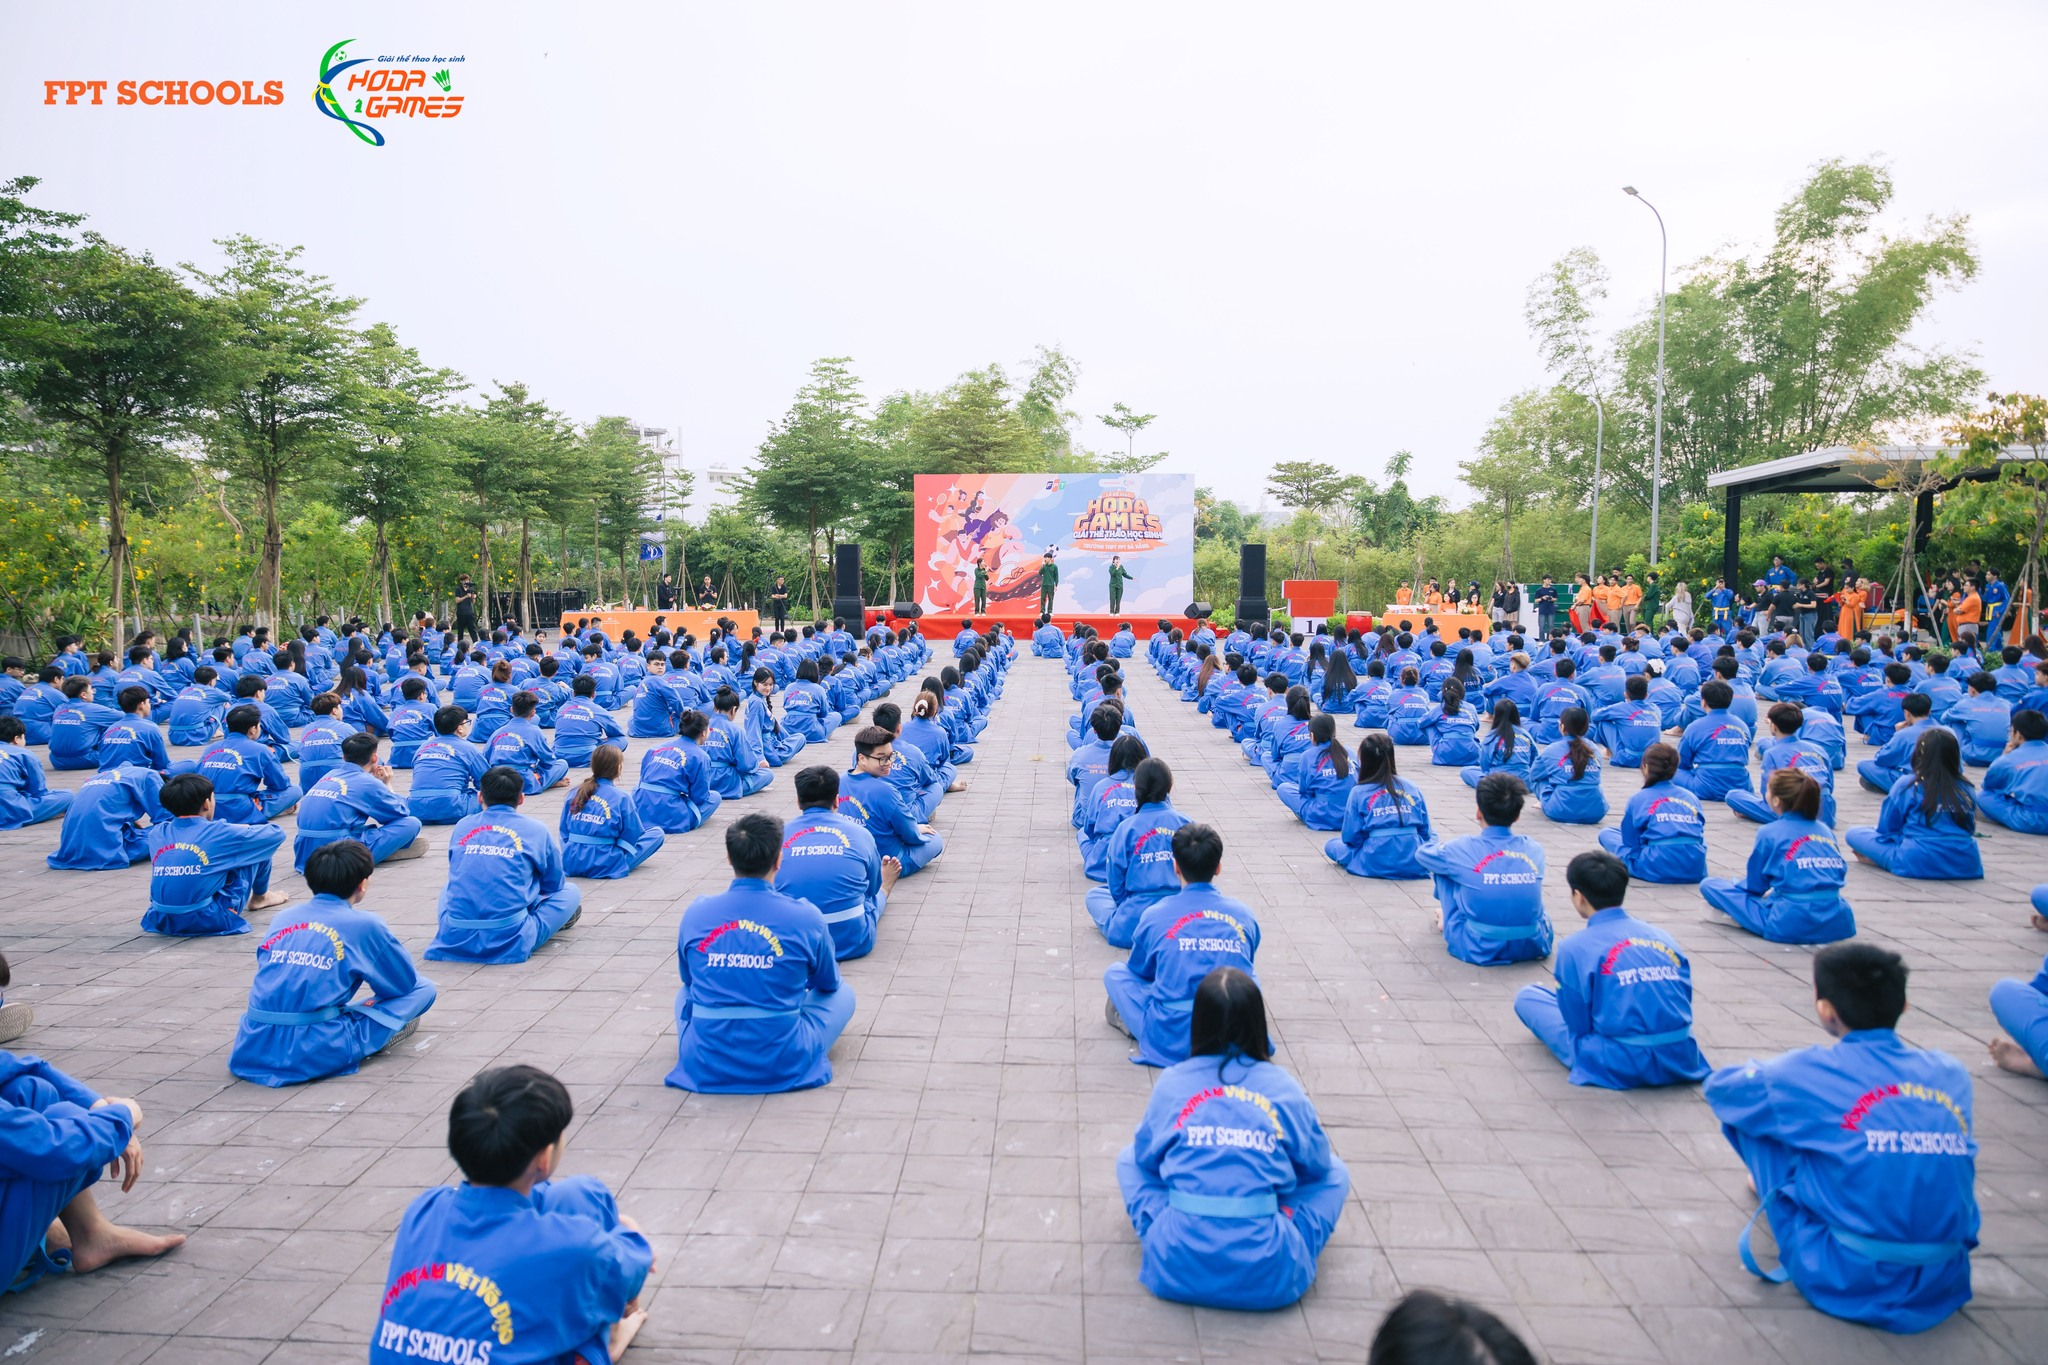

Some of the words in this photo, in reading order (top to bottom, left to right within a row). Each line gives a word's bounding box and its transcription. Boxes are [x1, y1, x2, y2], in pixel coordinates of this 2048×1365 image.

[1087, 497, 1149, 515] HODA
[1073, 511, 1163, 533] GAMES
[1305, 620, 1315, 634] 1
[464, 843, 480, 856] FPT
[479, 844, 516, 859] SCHOOLS
[791, 846, 807, 857] FPT
[806, 845, 844, 856] SCHOOLS
[1140, 851, 1154, 864] FPT
[153, 865, 166, 877] FPT
[165, 864, 201, 877] SCHOOLS
[1483, 873, 1500, 885] FPT
[1500, 873, 1536, 885] SCHOOLS
[738, 919, 759, 934] VIỆT
[260, 921, 309, 951] VOVINAM
[308, 921, 328, 934] VIỆT
[1178, 938, 1199, 952] FPT
[1199, 938, 1242, 954] SCHOOLS
[268, 950, 288, 964] FPT
[287, 950, 334, 971] SCHOOLS
[707, 952, 727, 968] FPT
[726, 953, 774, 970] SCHOOLS
[1616, 969, 1638, 987] FPT
[1638, 965, 1680, 984] SCHOOLS
[1186, 1125, 1215, 1147] FPT
[1215, 1126, 1277, 1155] SCHOOLS
[1864, 1130, 1900, 1154] FPT
[1899, 1131, 1969, 1157] SCHOOLS
[445, 1262, 484, 1292] VIỆT
[473, 1275, 503, 1308] VÕ
[489, 1300, 515, 1346] ĐẠO
[378, 1319, 411, 1358] FPT
[408, 1328, 493, 1365] SCHOOLS
